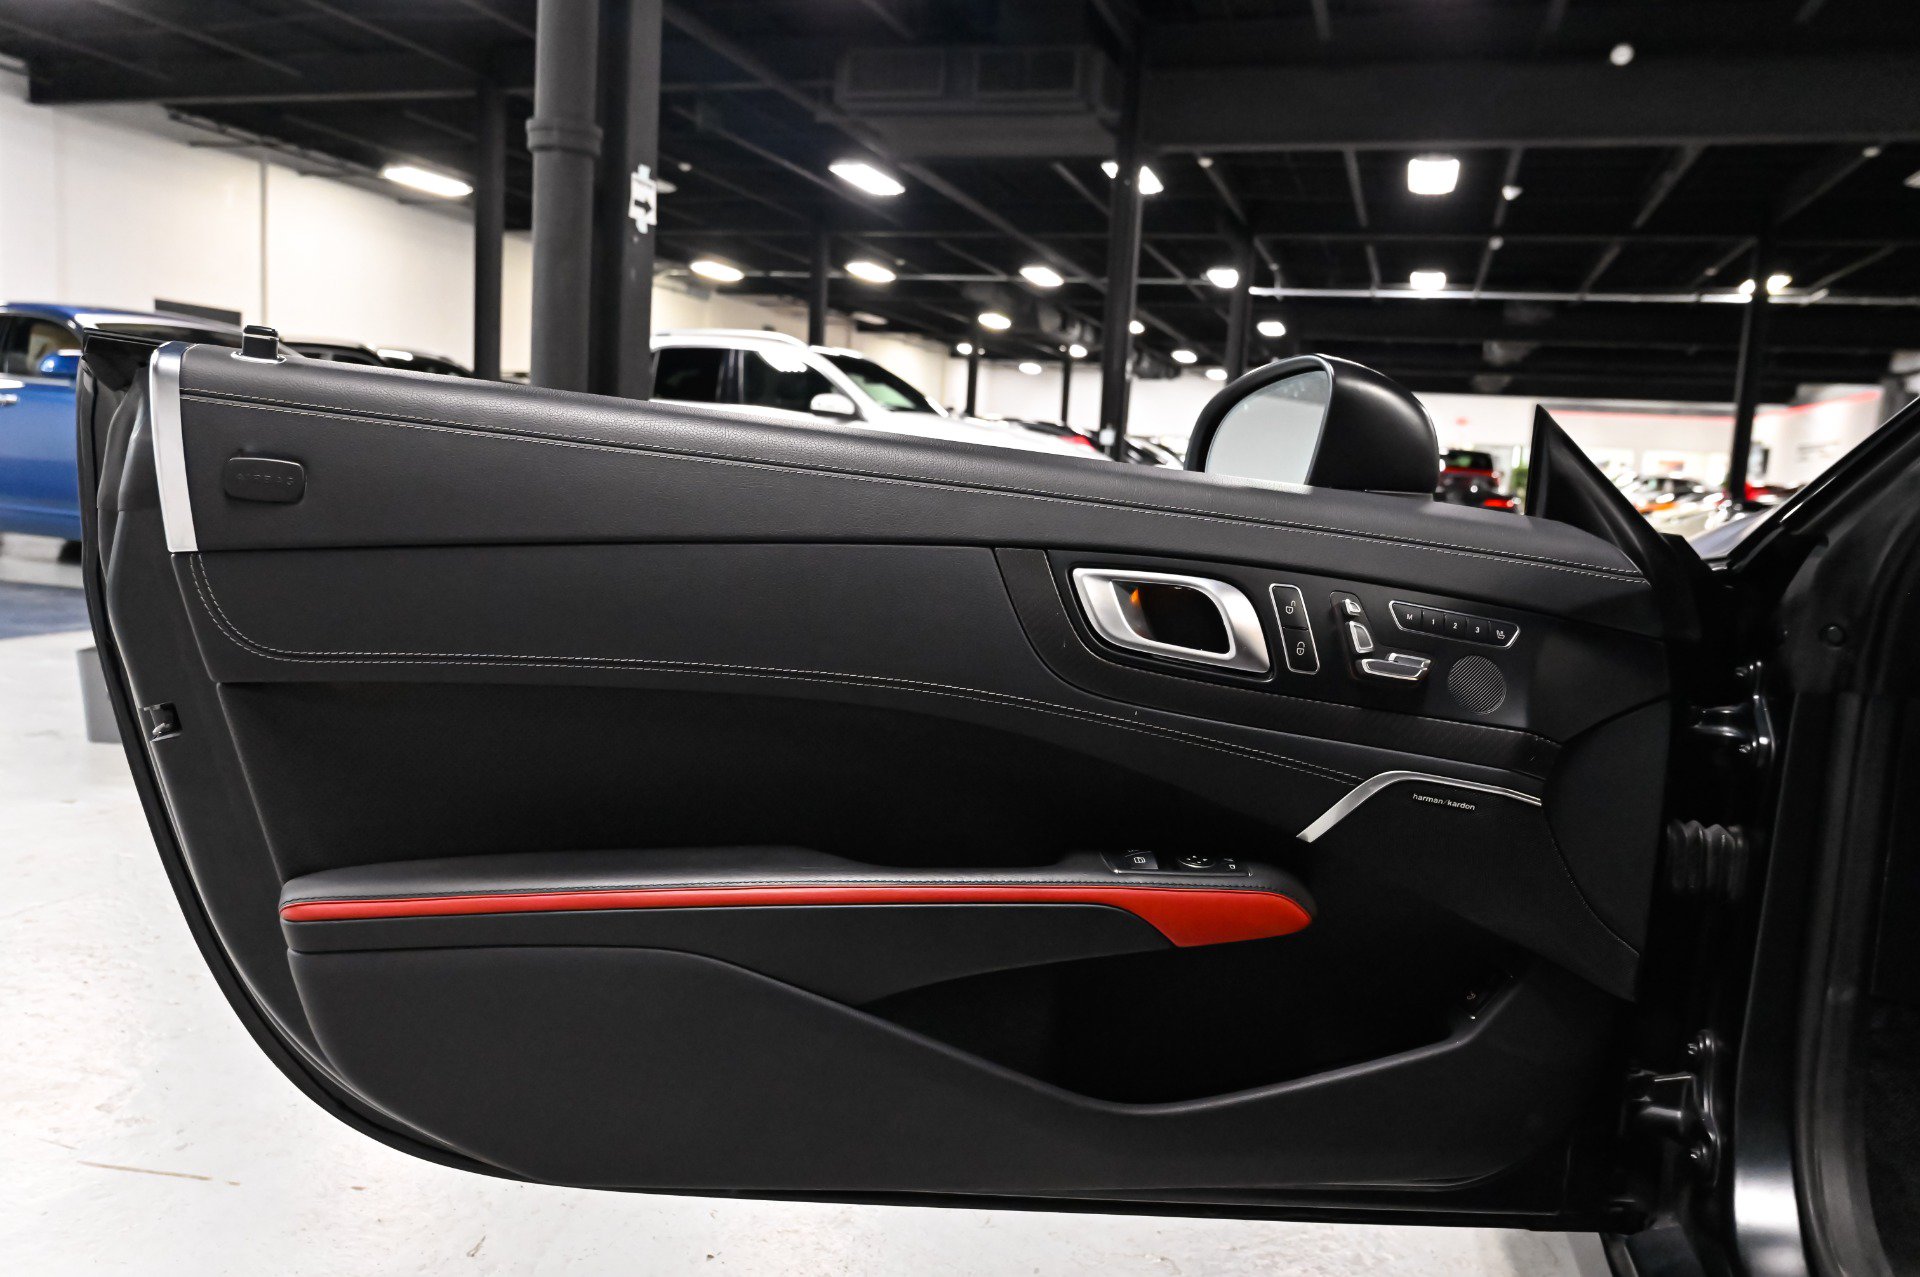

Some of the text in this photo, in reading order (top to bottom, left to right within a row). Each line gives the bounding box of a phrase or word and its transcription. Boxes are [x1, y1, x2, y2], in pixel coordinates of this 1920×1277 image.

[1406, 613, 1413, 621] M
[1453, 622, 1458, 630] 2
[1475, 626, 1480, 634] 3
